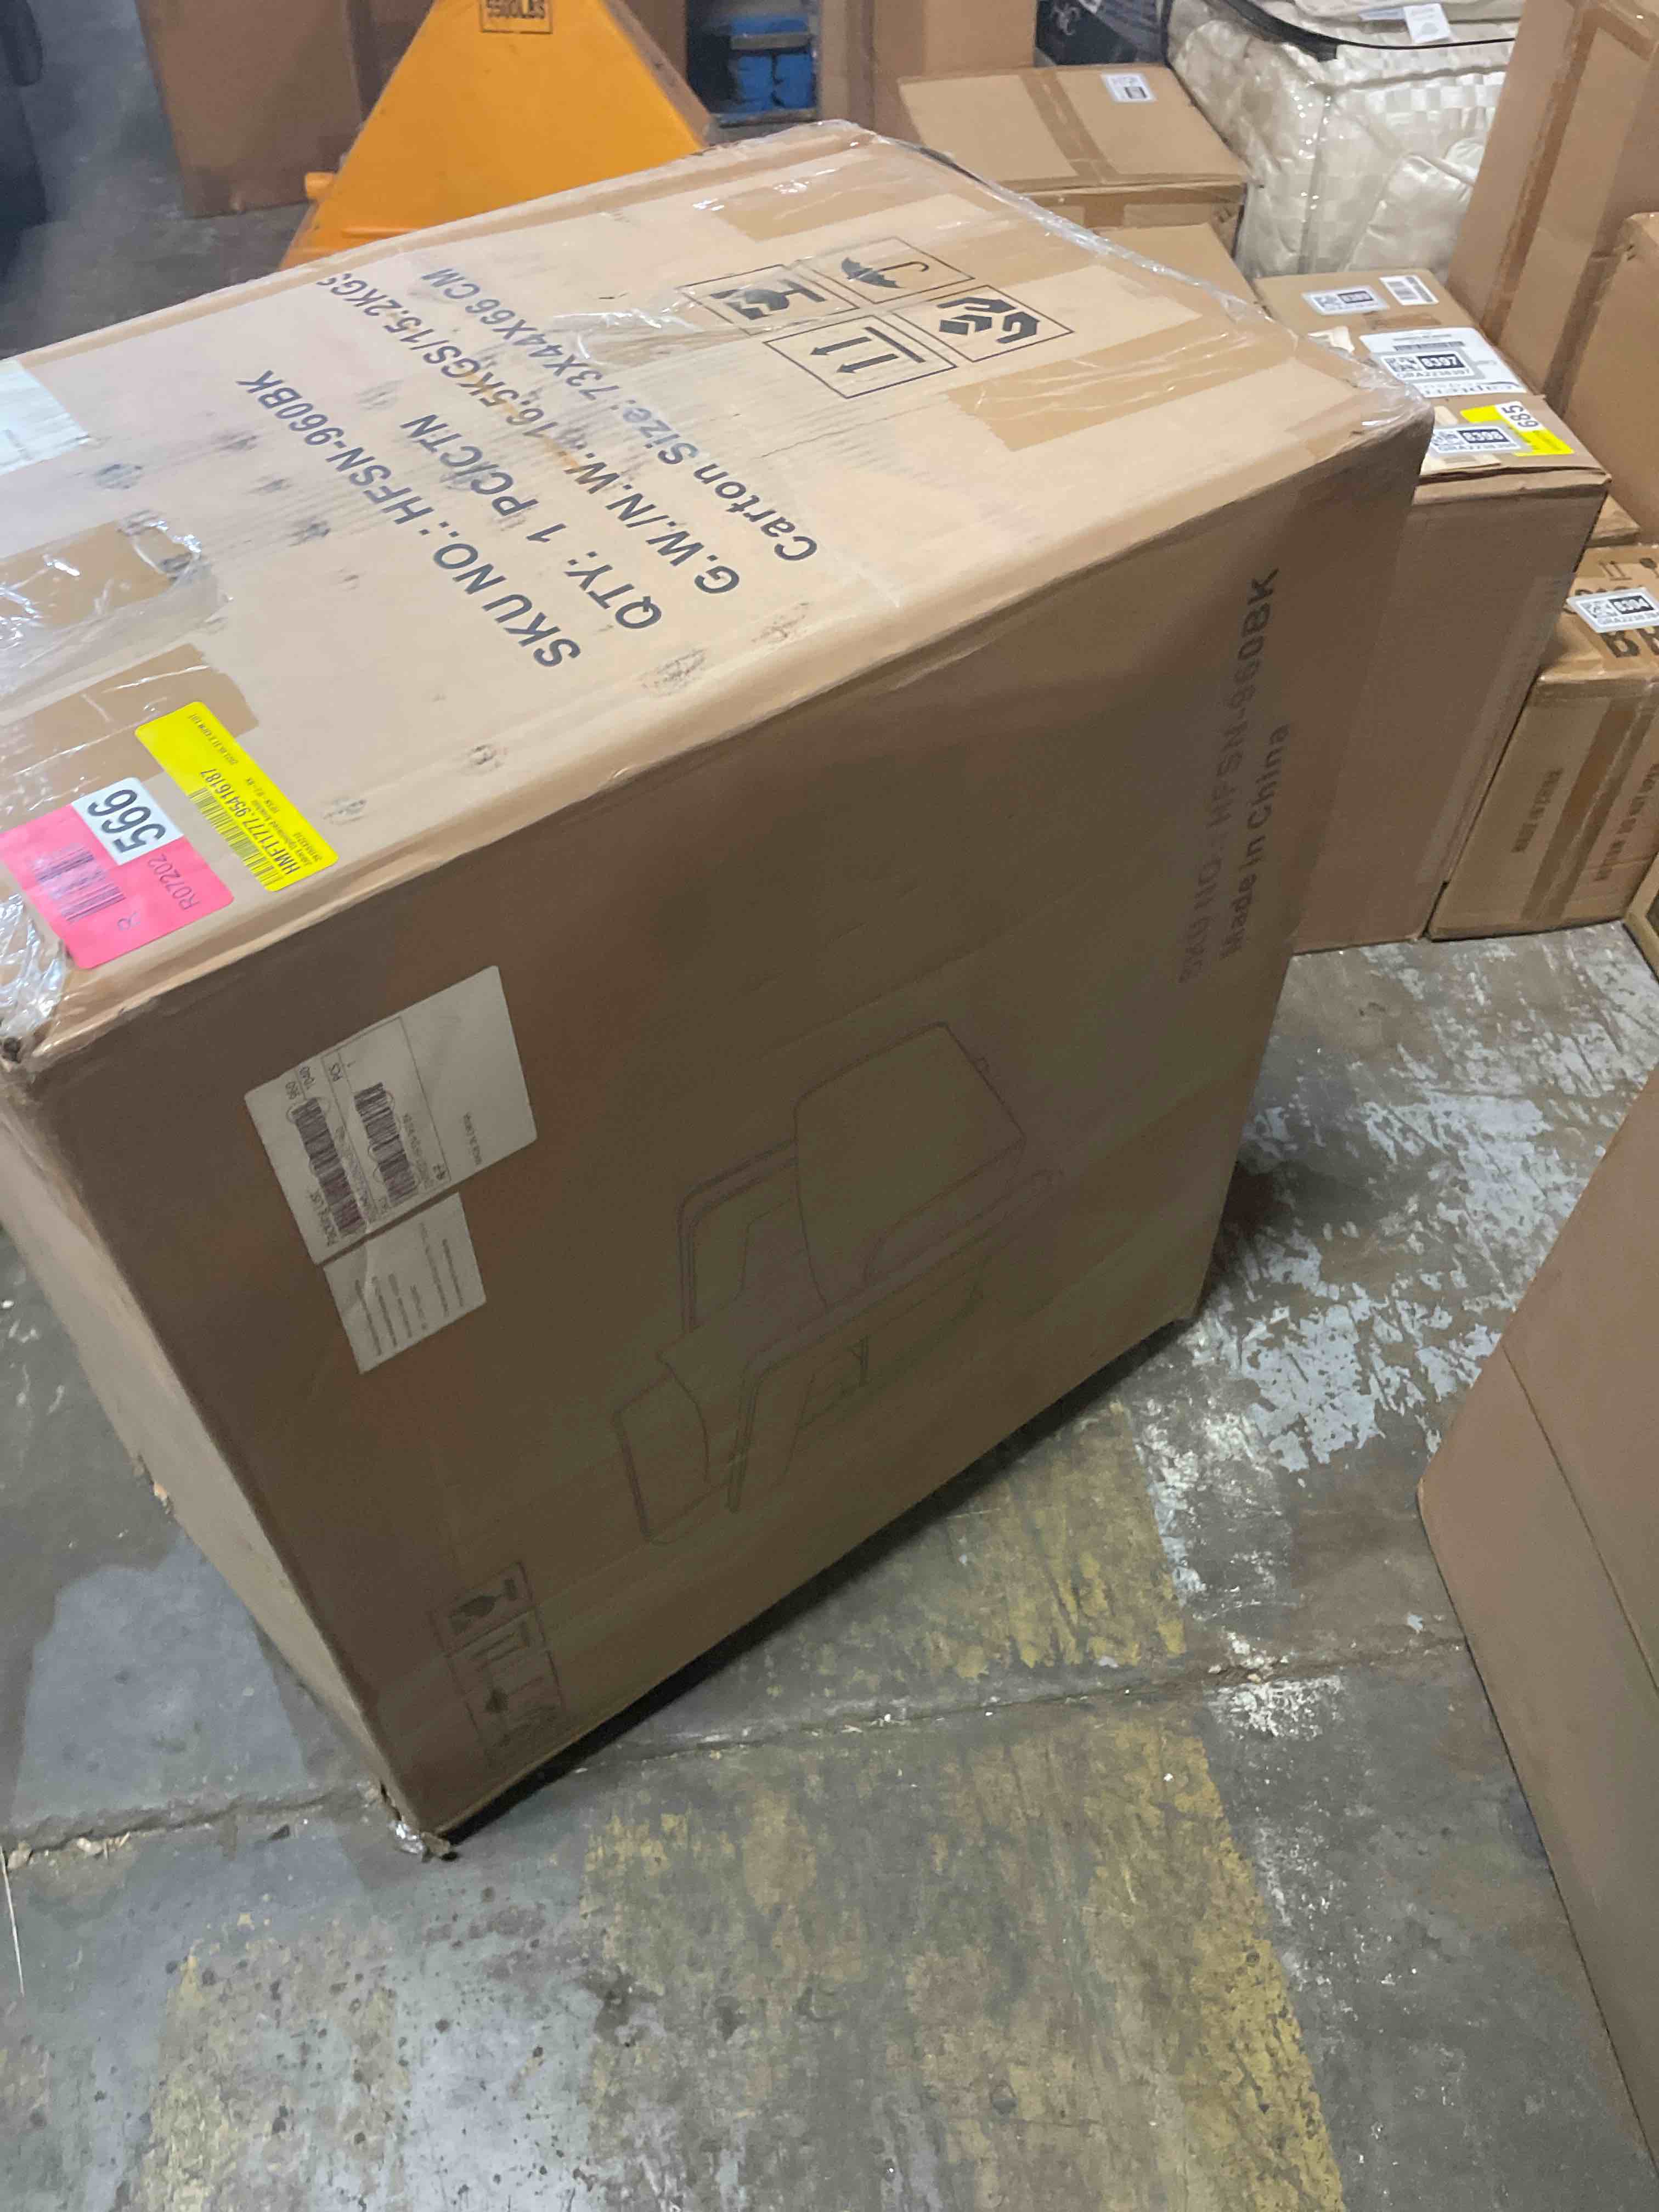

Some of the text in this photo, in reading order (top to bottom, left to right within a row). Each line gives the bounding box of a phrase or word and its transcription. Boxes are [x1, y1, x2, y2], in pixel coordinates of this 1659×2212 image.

[236, 370, 581, 667] SKU NO.: HFSN-960BK
[400, 414, 662, 629] QTY: 1 PC/CTN
[422, 268, 817, 561] Carton Size: 73X44X66 CM
[87, 788, 166, 854] 566
[147, 854, 201, 911] R07202
[200, 767, 301, 876] HMFT1777.95416187
[1221, 724, 1289, 961] Made in China
